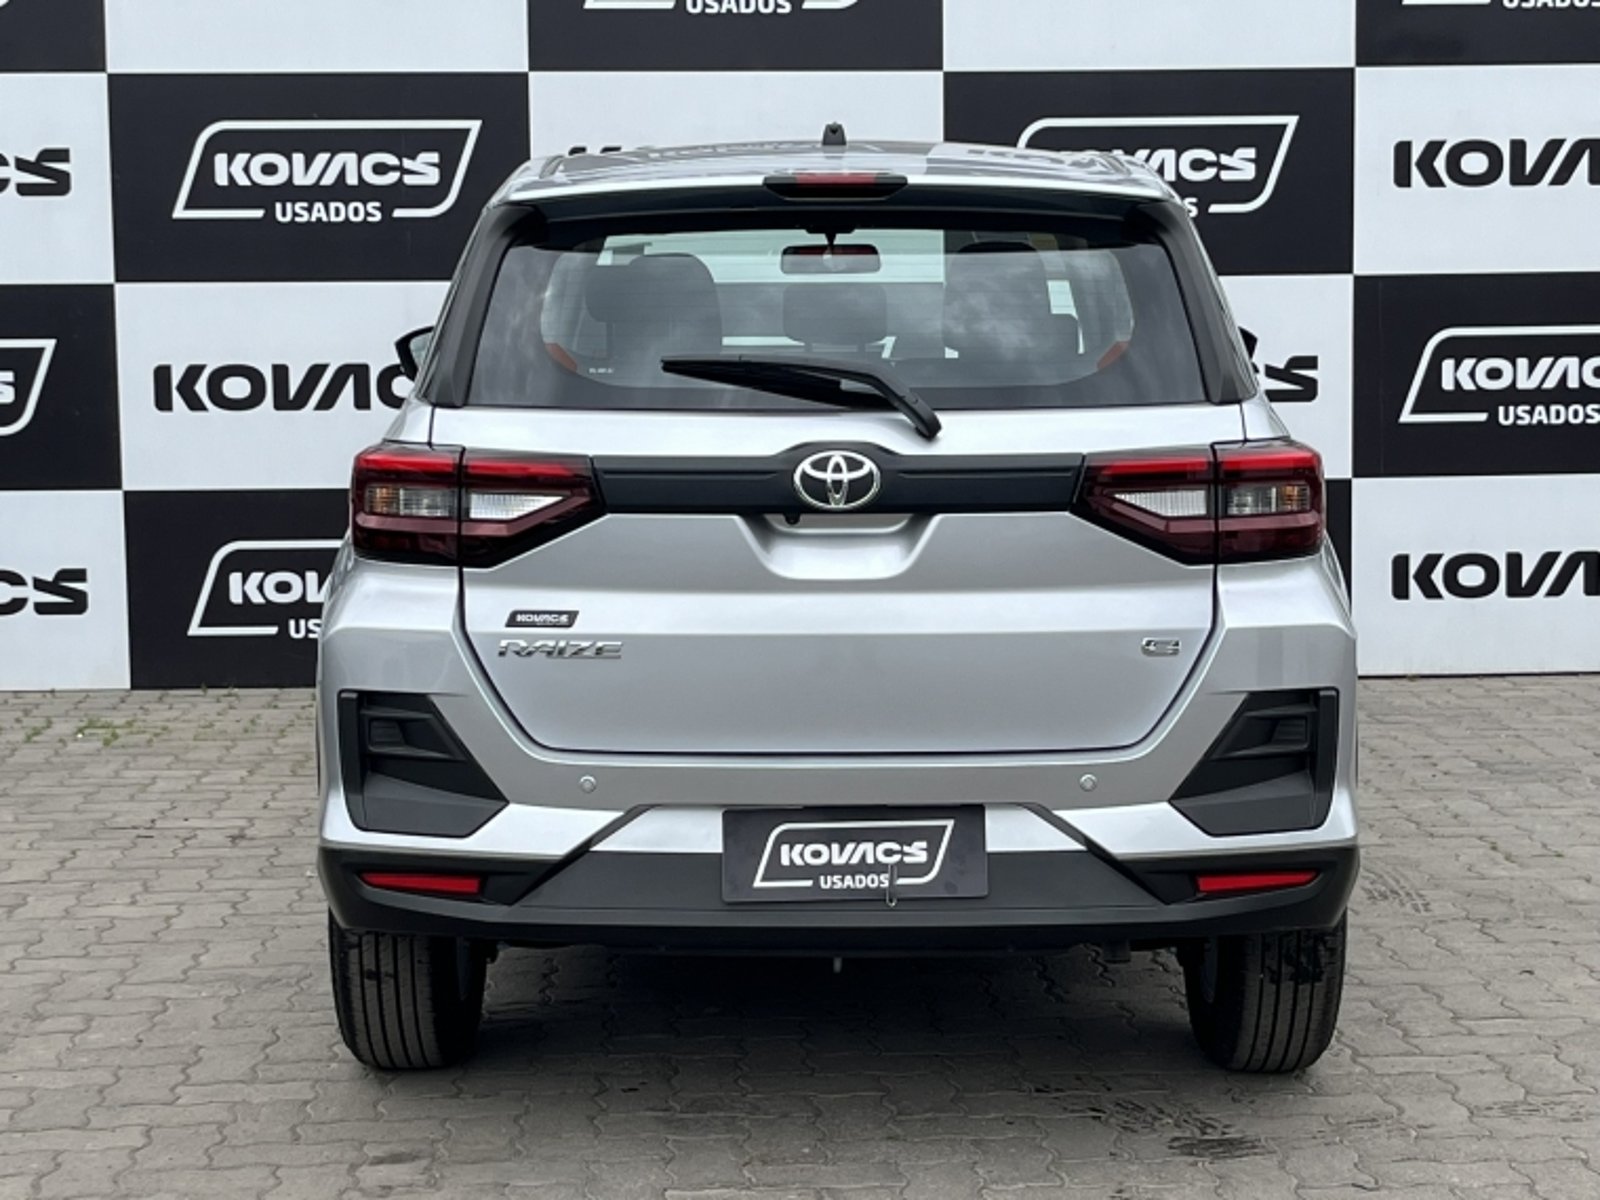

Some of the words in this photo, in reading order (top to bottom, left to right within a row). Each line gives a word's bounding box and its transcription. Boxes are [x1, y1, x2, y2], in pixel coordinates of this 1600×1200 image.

[213, 152, 441, 187] KOVACS
[1393, 138, 1600, 188] KOVA
[275, 201, 382, 223] USADOS
[1498, 403, 1600, 426] USADOS
[1391, 551, 1600, 600] KOVA
[498, 639, 622, 659] RAIZE
[780, 841, 928, 866] KOVACS
[820, 873, 889, 889] USADOS
